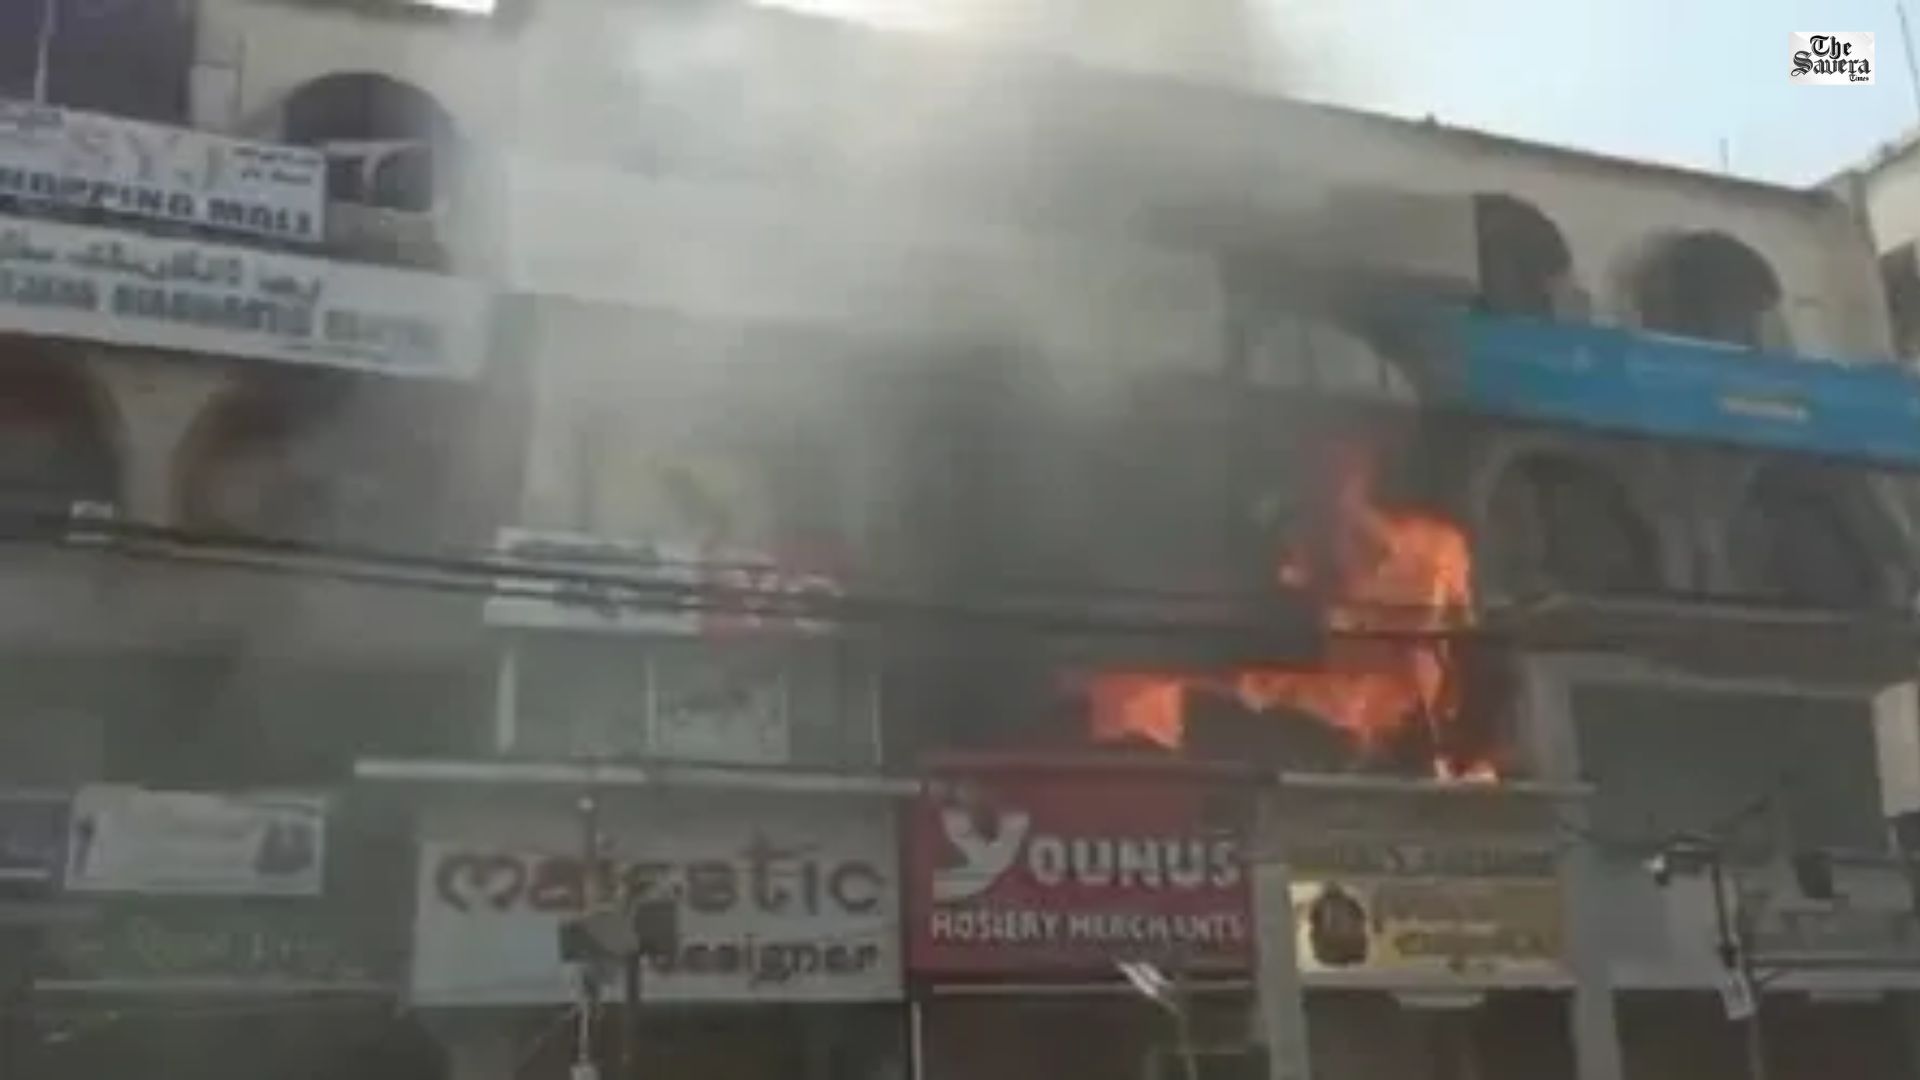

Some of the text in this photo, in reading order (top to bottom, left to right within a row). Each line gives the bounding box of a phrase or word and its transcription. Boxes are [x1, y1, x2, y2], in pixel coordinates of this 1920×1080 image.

[933, 808, 1241, 900] YOUNUS
[931, 909, 1246, 942] HOSIERY MERCHANTS
